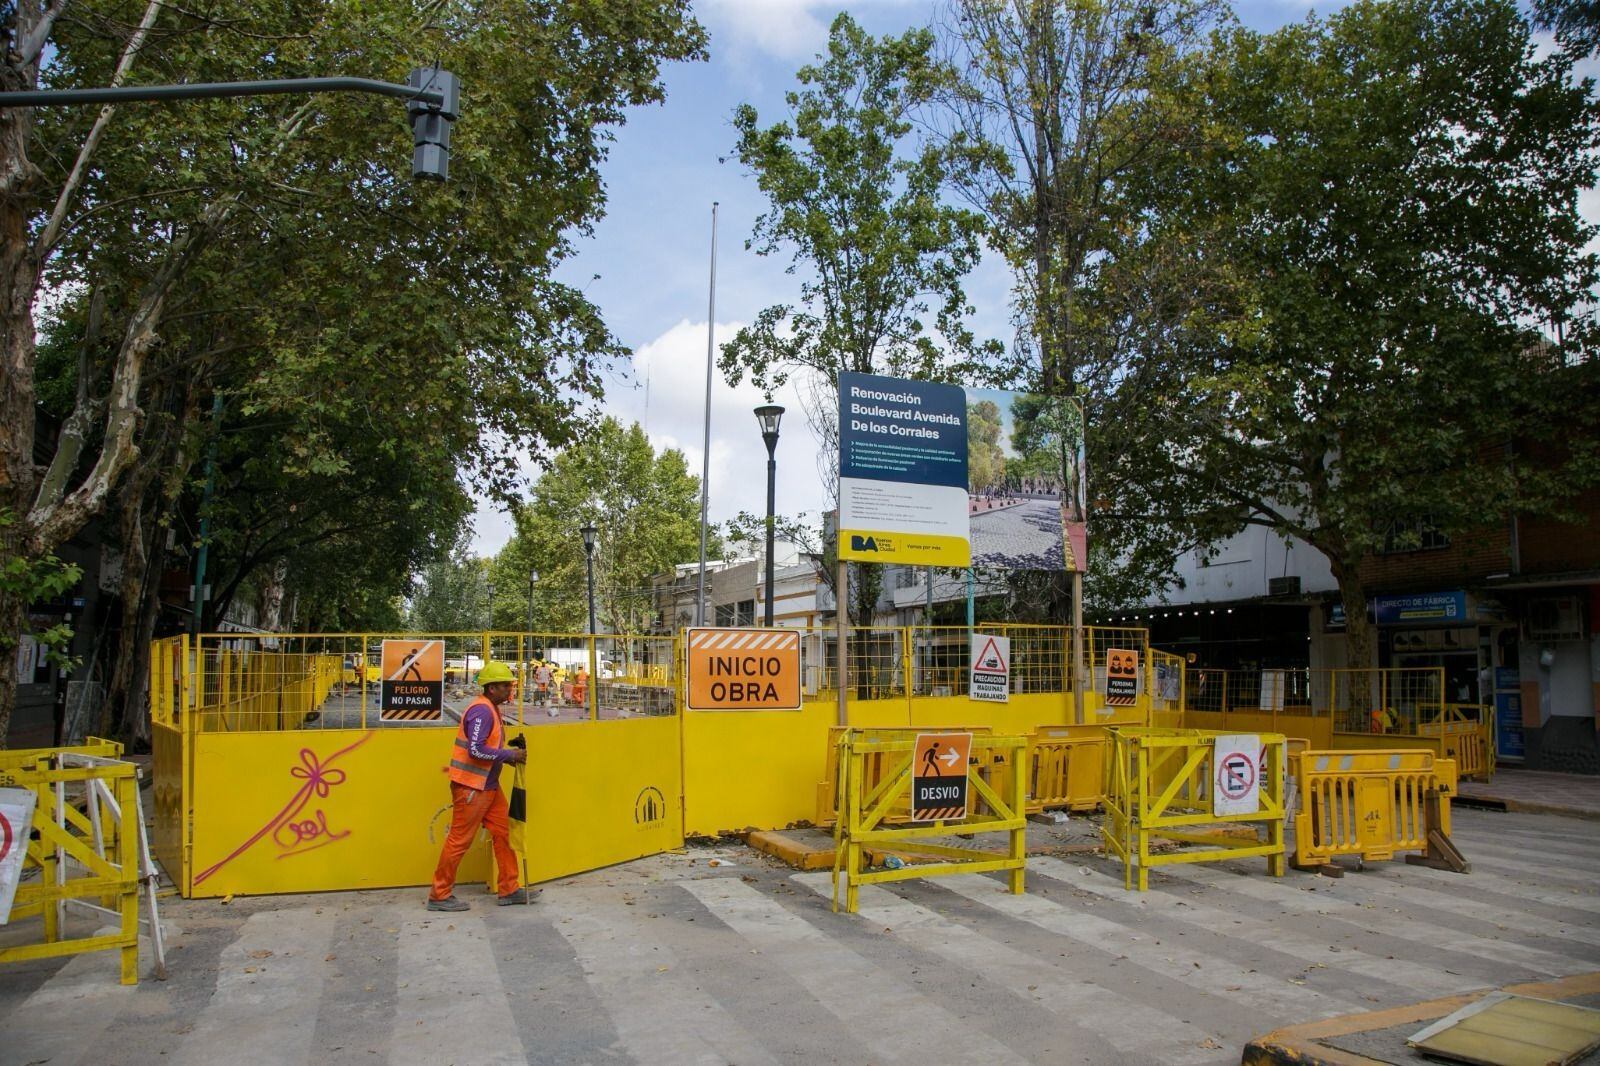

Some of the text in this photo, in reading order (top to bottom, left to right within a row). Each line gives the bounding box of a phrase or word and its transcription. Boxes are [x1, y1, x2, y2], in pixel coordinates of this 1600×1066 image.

[851, 386, 921, 405] Renovación
[851, 403, 961, 426] Boulevard Avenida
[851, 420, 940, 439] De los Corrales
[851, 535, 878, 552] BA
[1382, 599, 1412, 608] DIRECTO
[1412, 598, 1422, 606] DE
[709, 656, 781, 676] INICIO
[394, 686, 429, 694] PELIGRO
[710, 682, 779, 702] OBRA
[391, 696, 432, 705] NO PASAR
[471, 717, 482, 741] EAGLE
[1227, 762, 1245, 791] E
[921, 786, 960, 800] DESVIO
